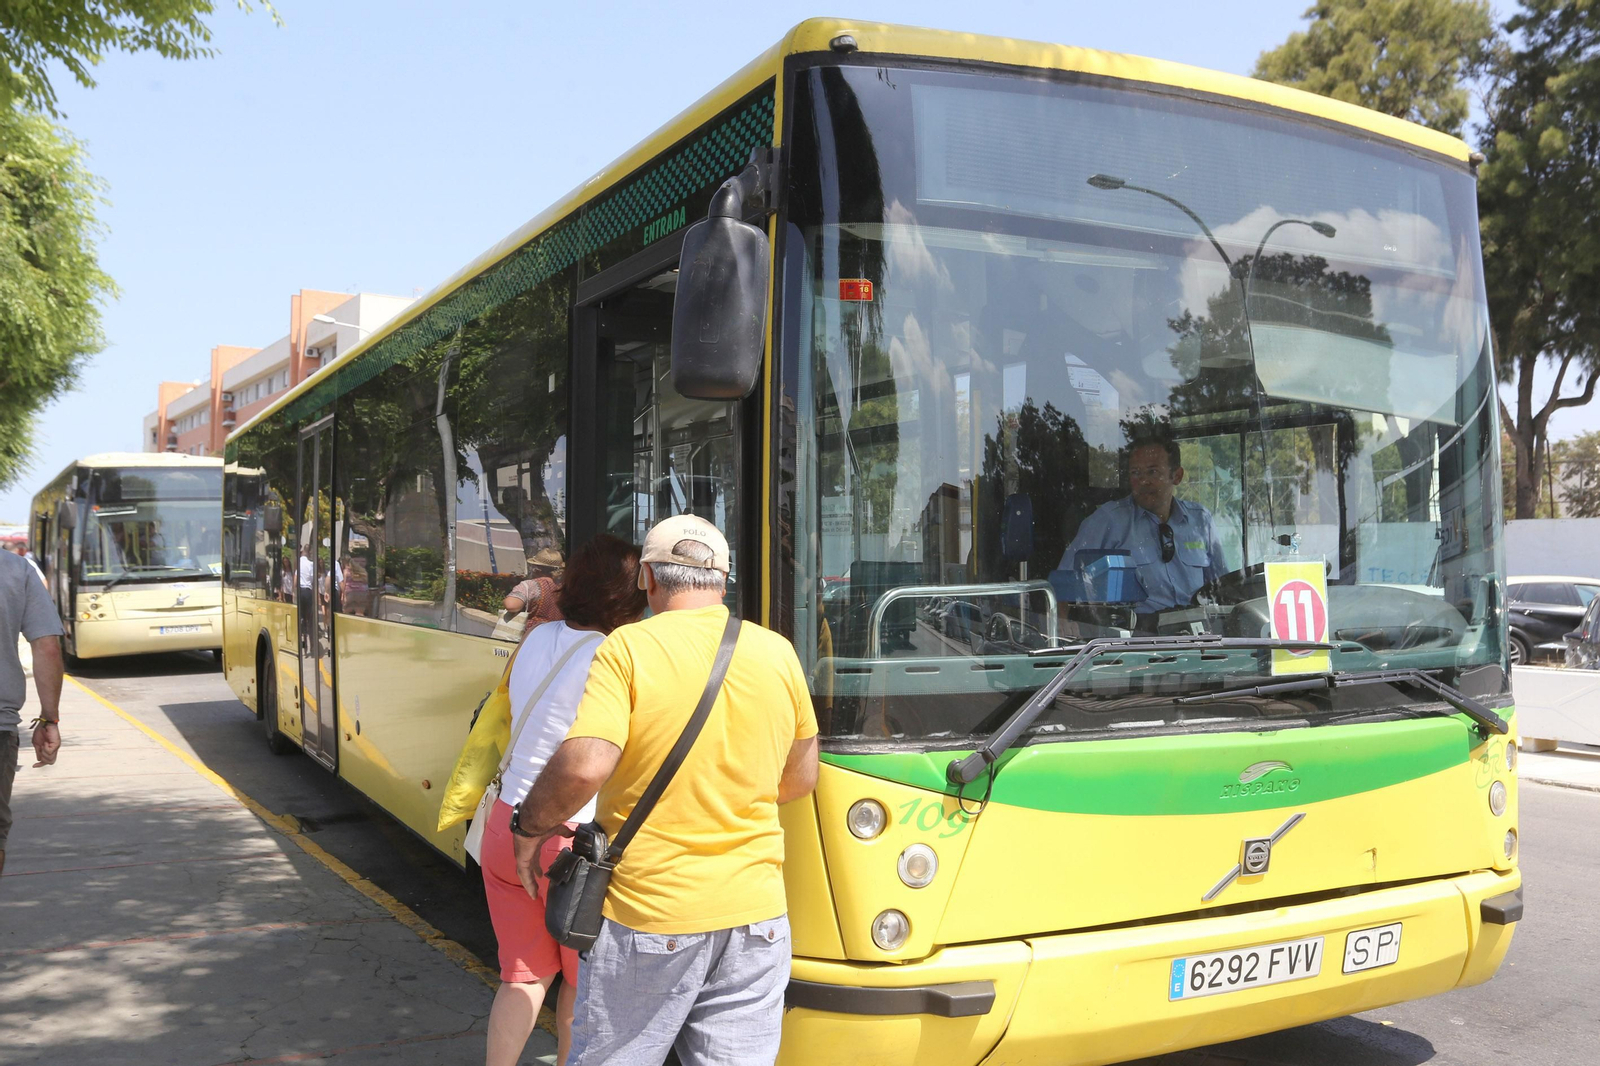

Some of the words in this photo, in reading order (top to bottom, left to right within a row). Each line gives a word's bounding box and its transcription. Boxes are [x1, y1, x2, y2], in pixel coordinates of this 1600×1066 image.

[643, 205, 686, 246] ENTRADA
[683, 529, 706, 537] POLO
[1280, 589, 1316, 642] 11
[1219, 778, 1301, 799] HISPANO
[898, 797, 970, 839] 109
[1247, 853, 1268, 861] VOLVO
[1174, 982, 1181, 992] E
[1190, 952, 1260, 992] 6292
[1268, 941, 1318, 979] FVV
